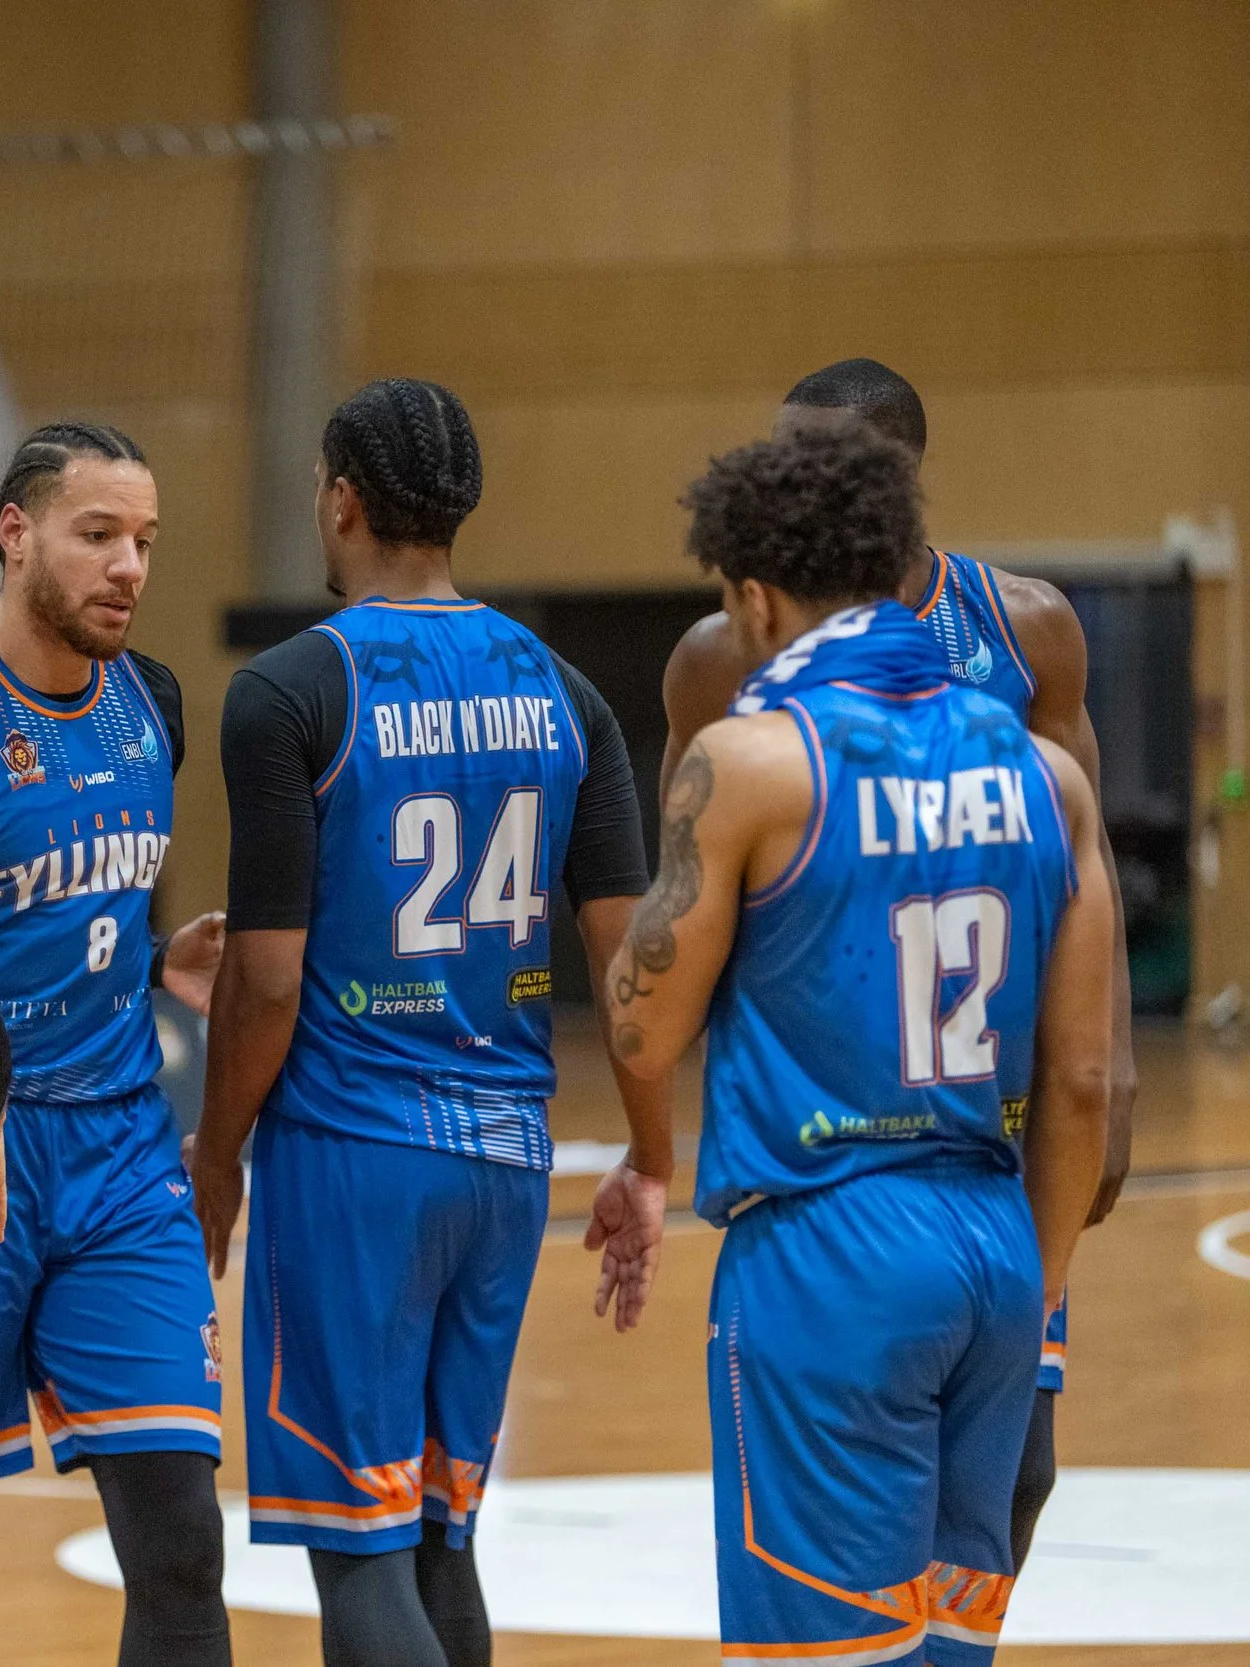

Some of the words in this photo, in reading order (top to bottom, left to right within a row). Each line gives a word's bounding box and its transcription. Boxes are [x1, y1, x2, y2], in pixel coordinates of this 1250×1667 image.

[373, 700, 455, 759] BLACK
[459, 694, 559, 755] N'DIAYE
[122, 742, 145, 761] ENBL
[85, 770, 115, 786] WIBO
[48, 809, 155, 845] LIONS
[391, 786, 548, 958] 24
[87, 915, 118, 973] 8
[372, 980, 448, 998] HALTBAKK
[889, 886, 1012, 1088] 12
[371, 998, 445, 1015] EXPRESS
